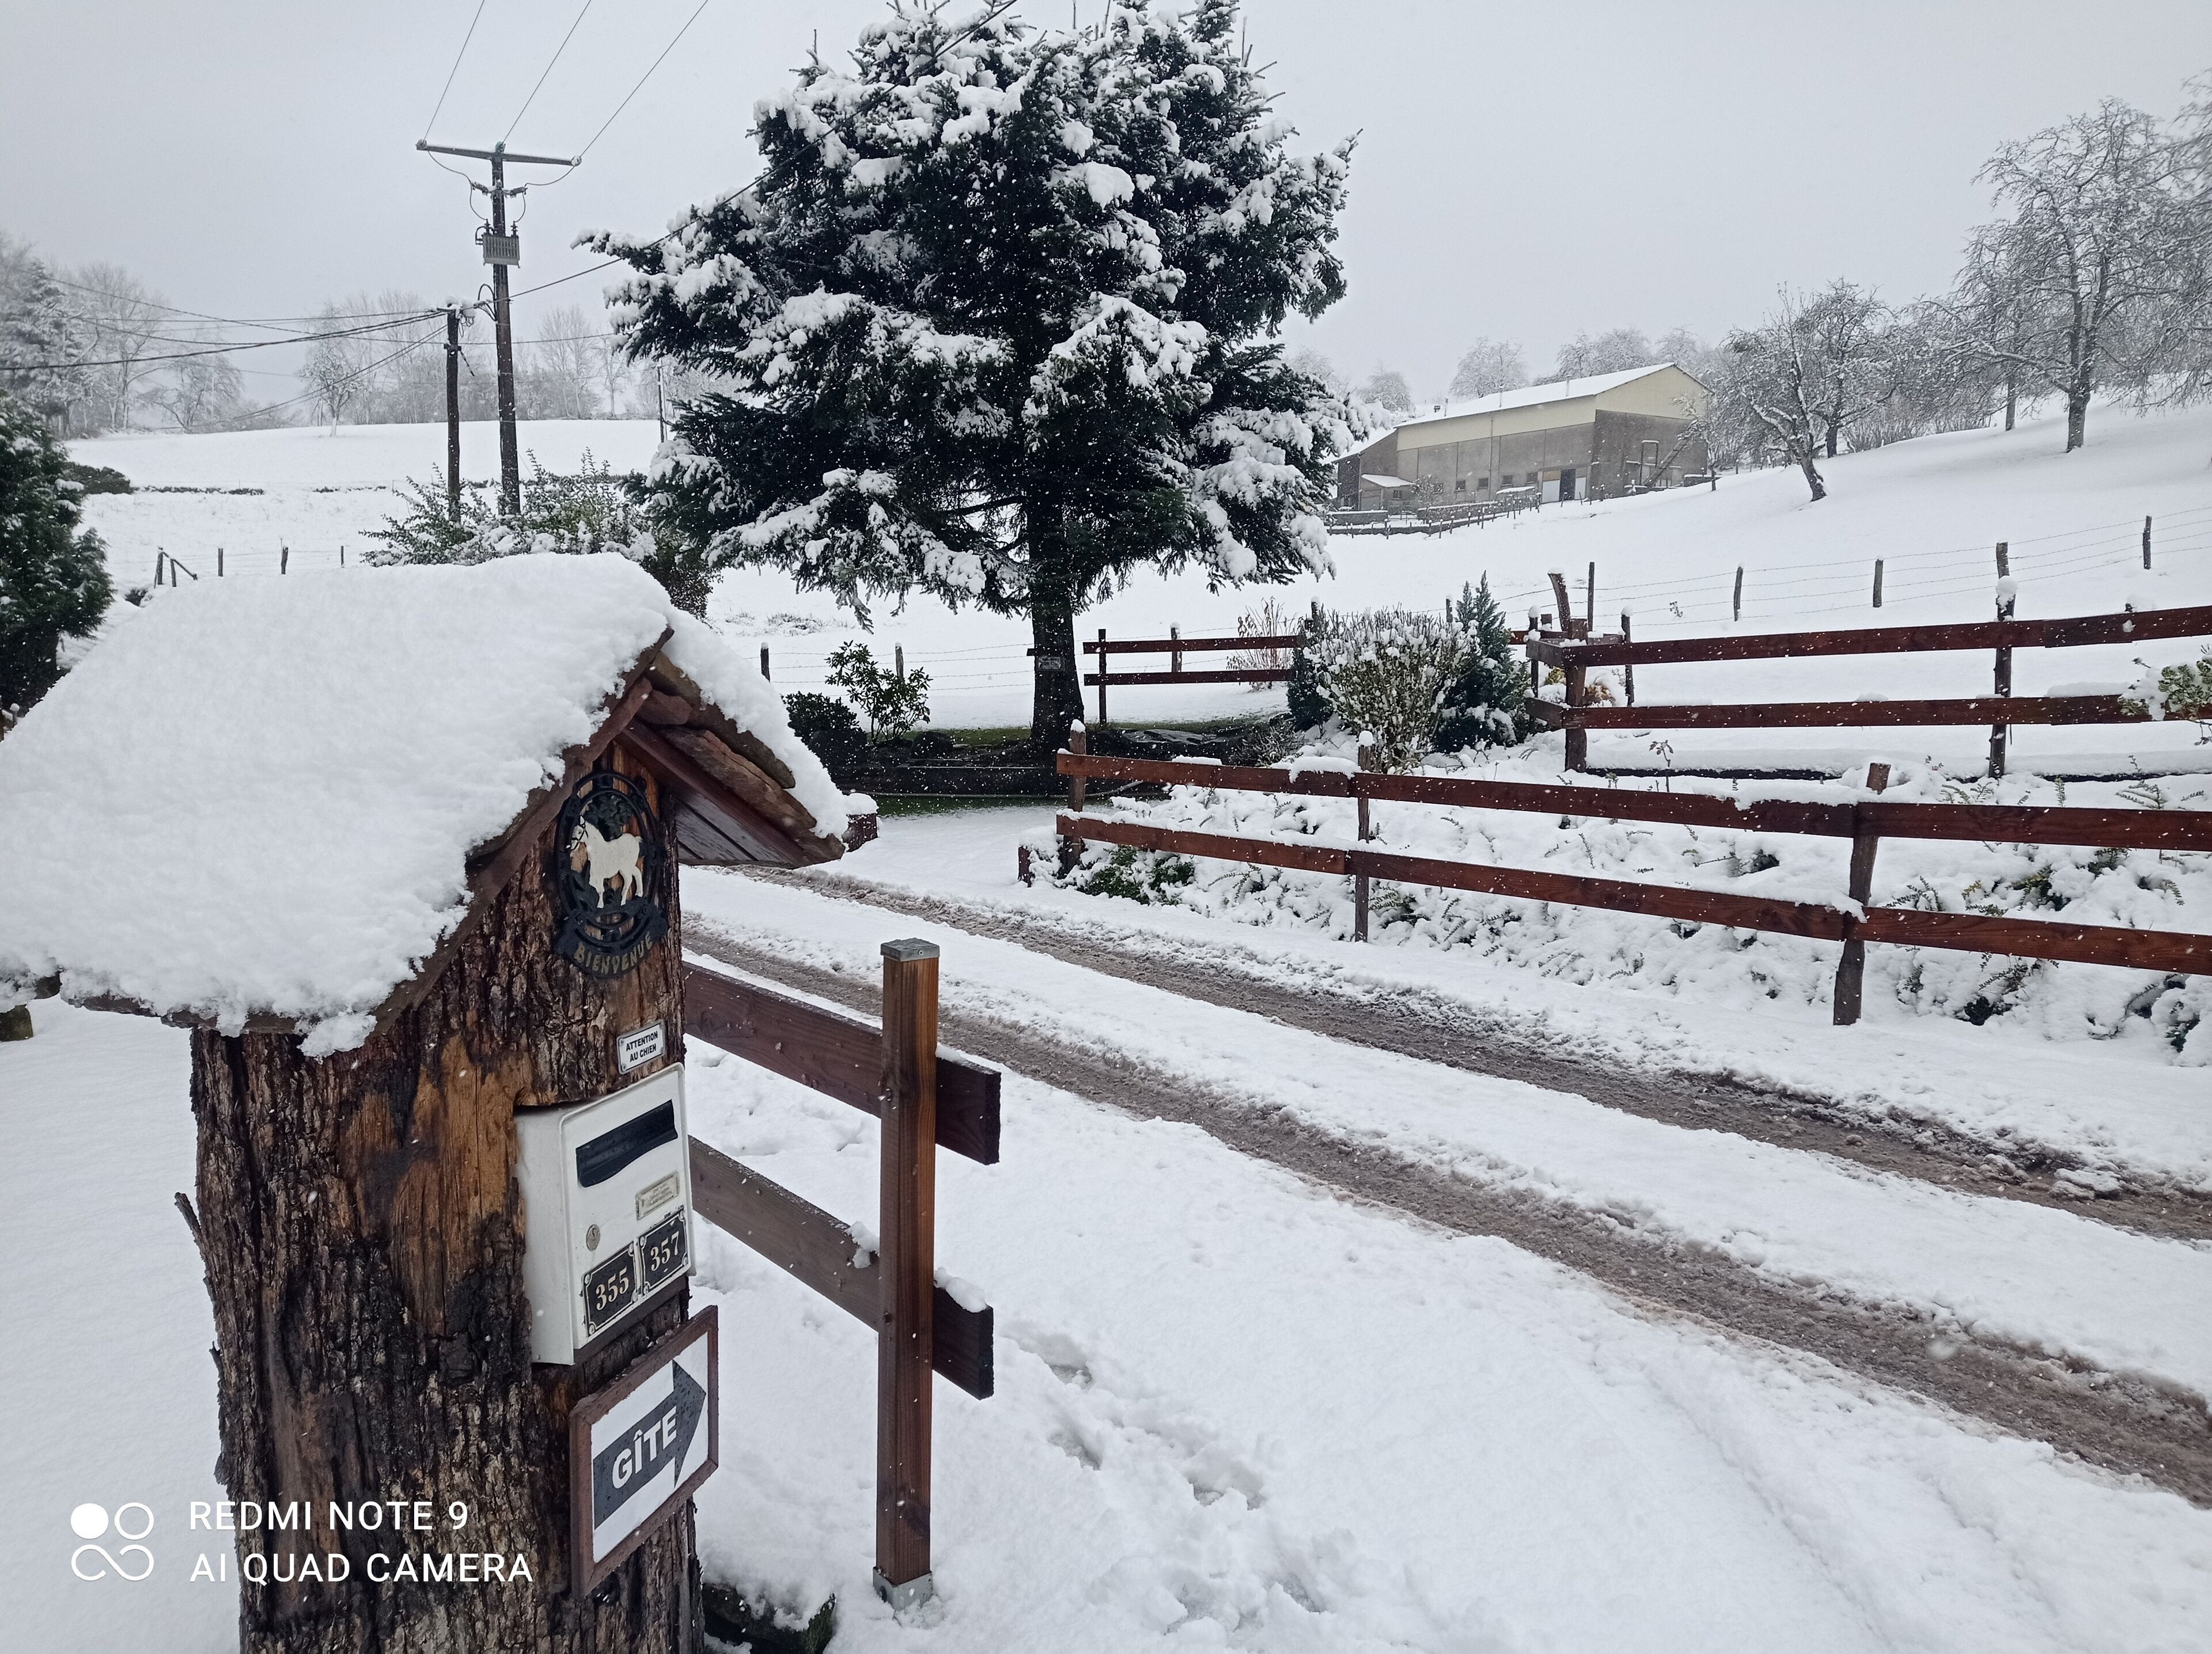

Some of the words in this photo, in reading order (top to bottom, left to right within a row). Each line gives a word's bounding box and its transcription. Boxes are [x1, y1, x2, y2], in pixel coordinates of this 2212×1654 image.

[574, 931, 653, 974] BIENVENUE
[626, 1031, 658, 1052] ATTENTION
[630, 1052, 638, 1062] AU
[639, 1044, 657, 1057] CHIEN
[650, 1231, 680, 1272] 357
[596, 1266, 629, 1311] 355
[612, 1405, 677, 1489] GÎTE
